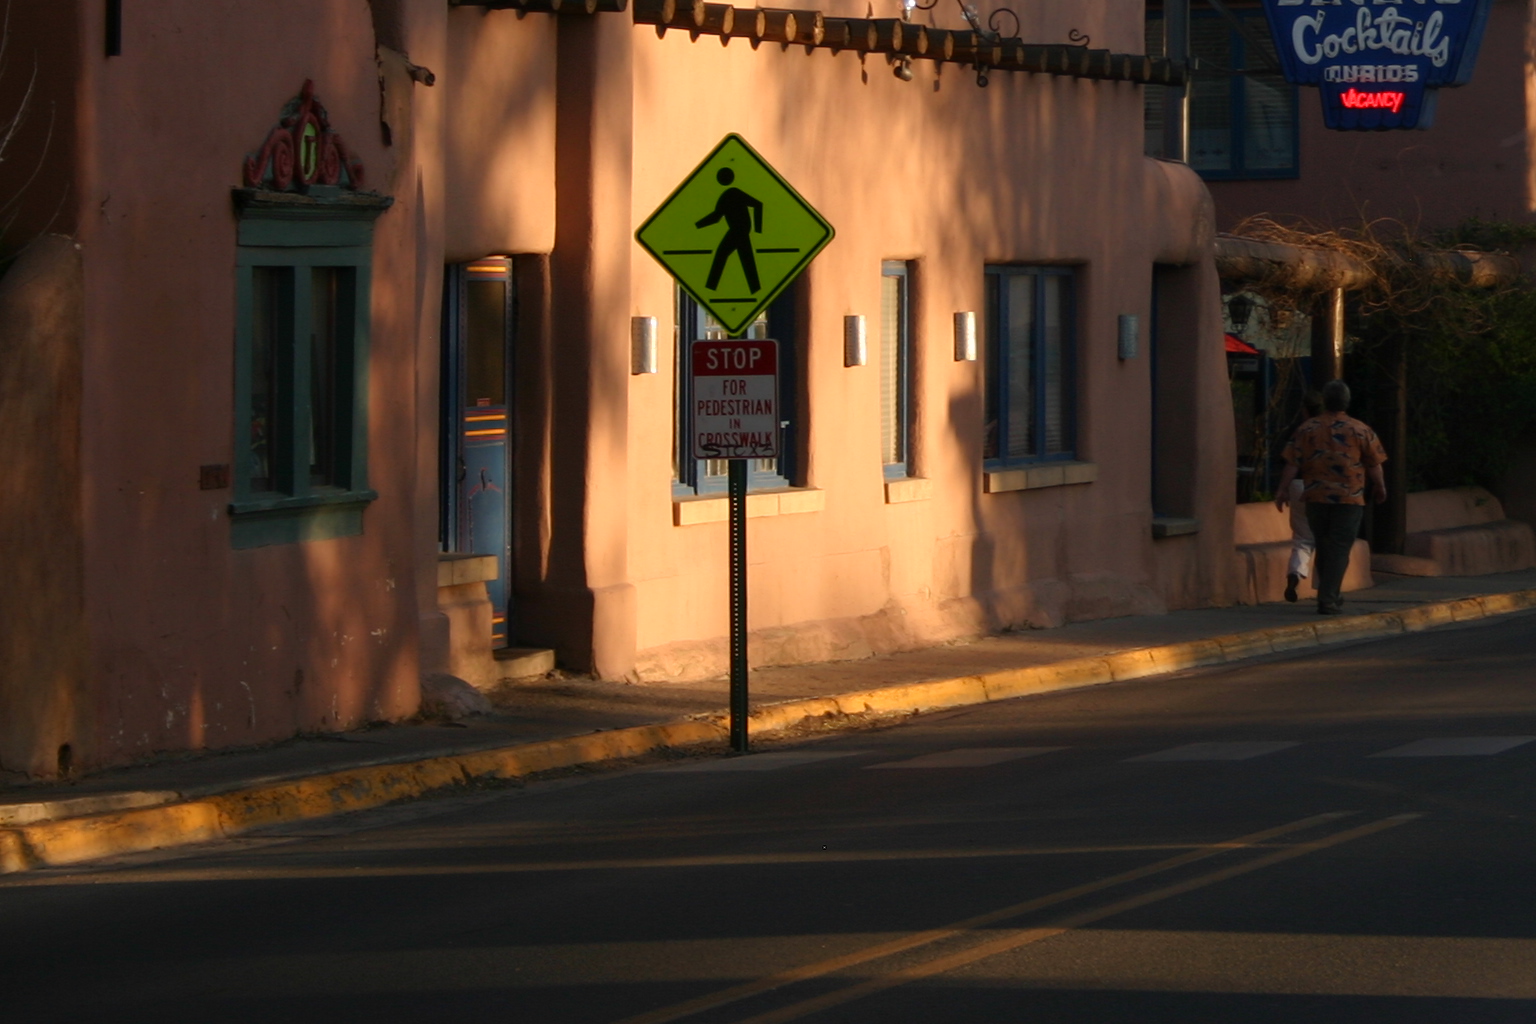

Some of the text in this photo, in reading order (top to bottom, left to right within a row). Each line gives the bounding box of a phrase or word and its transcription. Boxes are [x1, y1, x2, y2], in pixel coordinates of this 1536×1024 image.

[1292, 6, 1449, 67] Cocktails
[1324, 64, 1419, 82] CURIOS
[1340, 88, 1405, 113] VACANCY
[706, 348, 762, 370] STOP
[722, 379, 747, 395] FOR
[697, 399, 772, 416] PEDESTRIAN
[729, 418, 741, 430] IN
[698, 431, 773, 448] CROSSWALK
